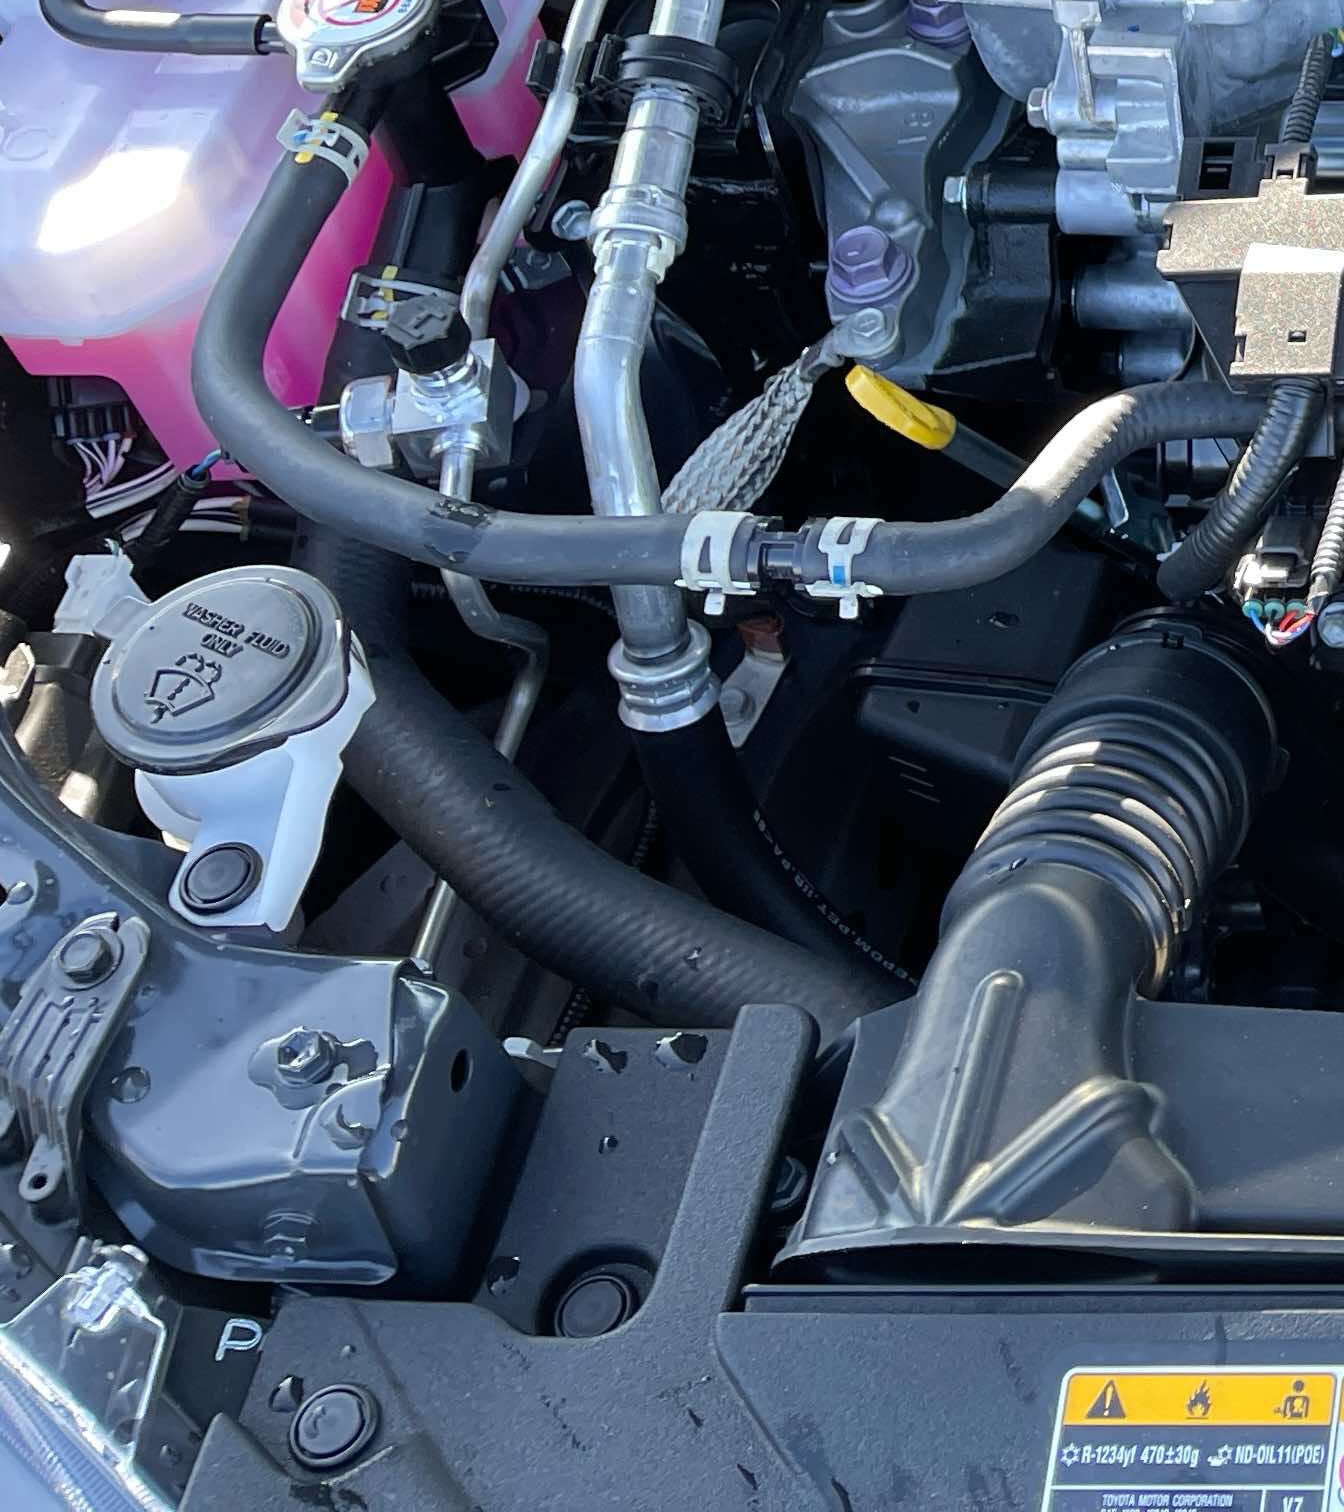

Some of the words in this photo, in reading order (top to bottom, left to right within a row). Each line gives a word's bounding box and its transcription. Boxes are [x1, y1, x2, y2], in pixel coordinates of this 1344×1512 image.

[182, 602, 245, 639] WASHER
[244, 631, 290, 659] FLUID
[200, 633, 243, 658] ONLY
[215, 1319, 263, 1361] P
[1081, 1445, 1138, 1468] R-1234yf
[1140, 1445, 1200, 1468] 470±30g
[1234, 1444, 1325, 1465] ND-OIL11(POE)
[1102, 1493, 1136, 1507] TOYOTA
[1138, 1493, 1170, 1507] MOTOR
[1172, 1493, 1234, 1507] CORPORATION
